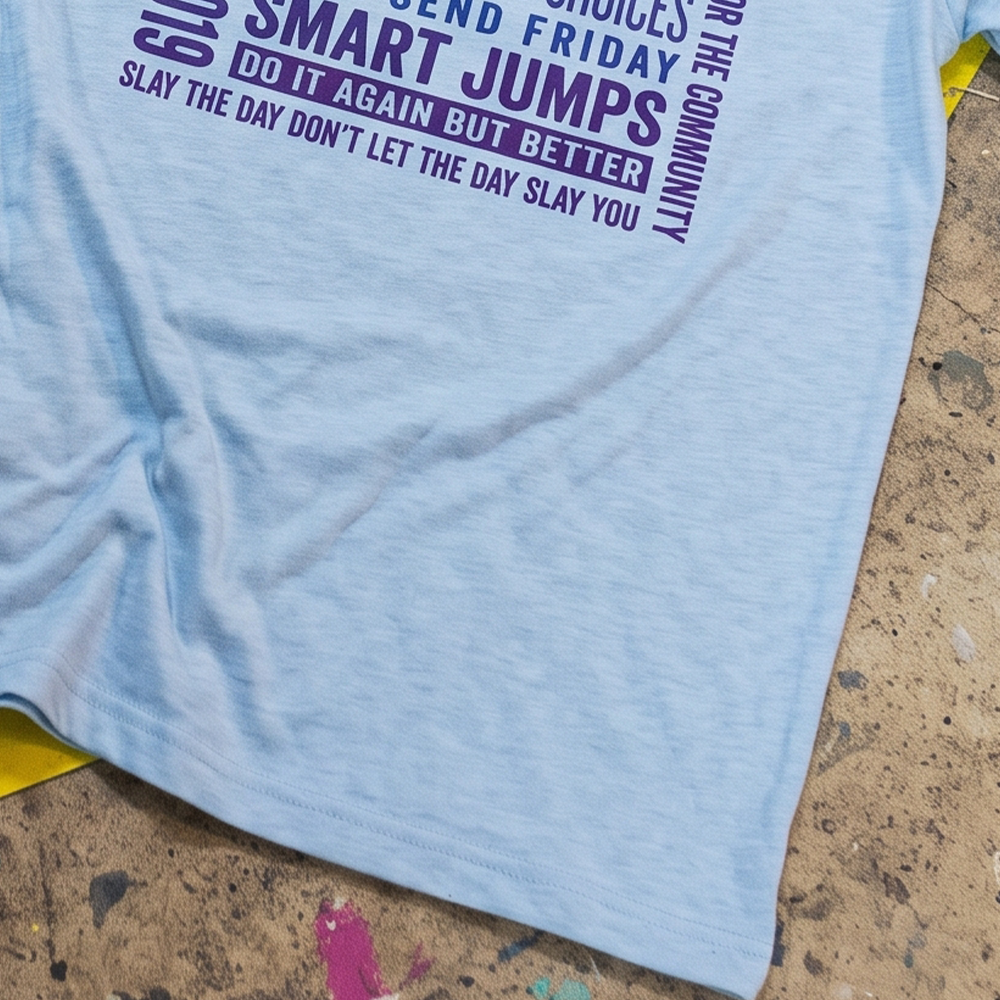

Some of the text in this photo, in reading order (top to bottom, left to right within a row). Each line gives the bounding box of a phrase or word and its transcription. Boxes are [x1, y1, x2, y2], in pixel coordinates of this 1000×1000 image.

[460, 46, 667, 147] JUMPS
[522, 13, 681, 84] FRIDAY
[691, 30, 739, 82] THE
[118, 60, 641, 232] SLAY THE DAY DON'T LET THE DAY SLAY YOU
[237, 48, 644, 188] DO IT AGAIN BUT BETTER
[652, 83, 724, 245] COMMUNITY
